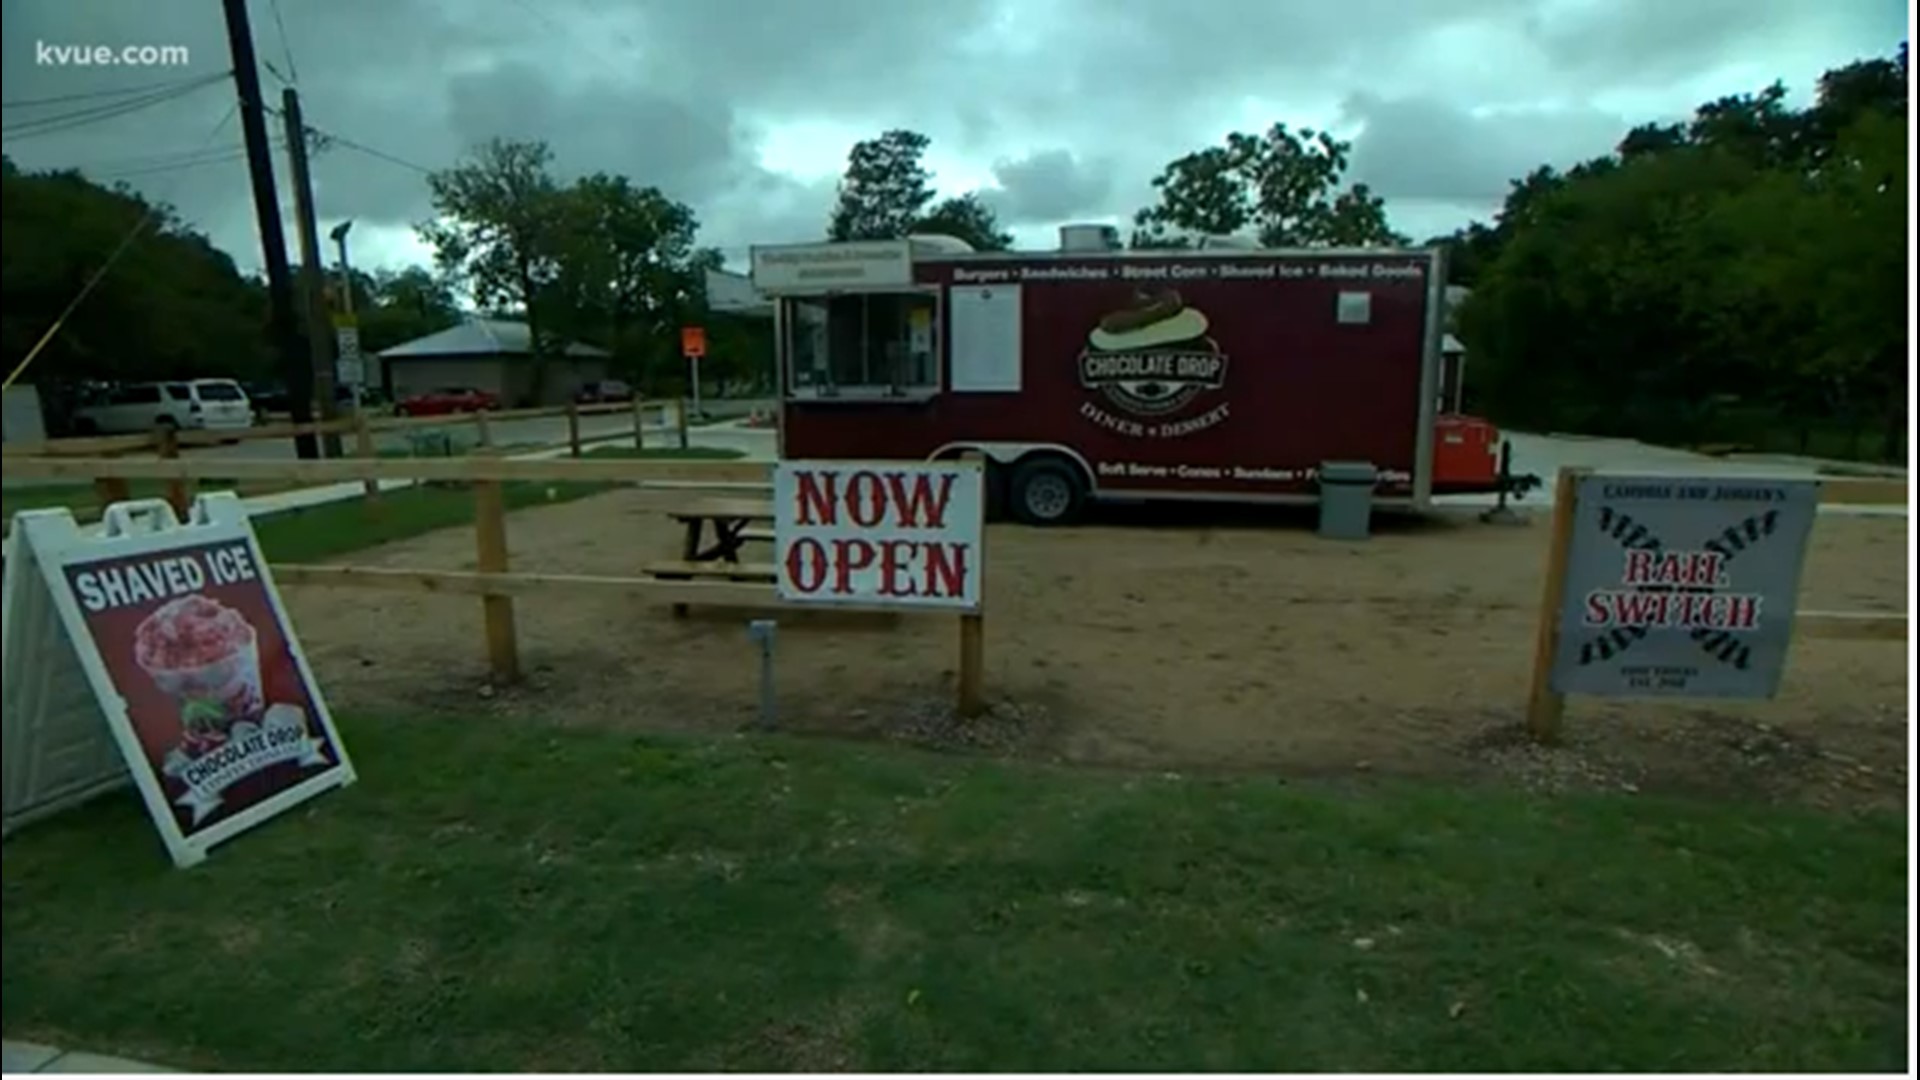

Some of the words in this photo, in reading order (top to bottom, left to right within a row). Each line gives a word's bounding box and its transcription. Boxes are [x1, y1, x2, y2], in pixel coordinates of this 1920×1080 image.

[954, 267, 1009, 282] Burgers
[1122, 265, 1167, 279] Street
[1279, 264, 1304, 277] Ice
[1319, 264, 1369, 277] Baked
[1085, 354, 1175, 377] CHOCOLATE
[1176, 355, 1221, 378] DROP
[1079, 401, 1144, 437] DINER
[1160, 402, 1231, 437] DESSERT
[1098, 461, 1126, 475] Soft
[1129, 463, 1167, 477] Serve
[794, 471, 958, 527] NOW
[76, 557, 204, 610] SHAVED
[208, 546, 255, 585] ICE
[785, 537, 970, 598] OPEN
[1624, 550, 1729, 586] RAIL
[1586, 592, 1761, 629] SWITCH
[186, 733, 267, 786] CHOCOLATE
[267, 725, 304, 748] DROP
